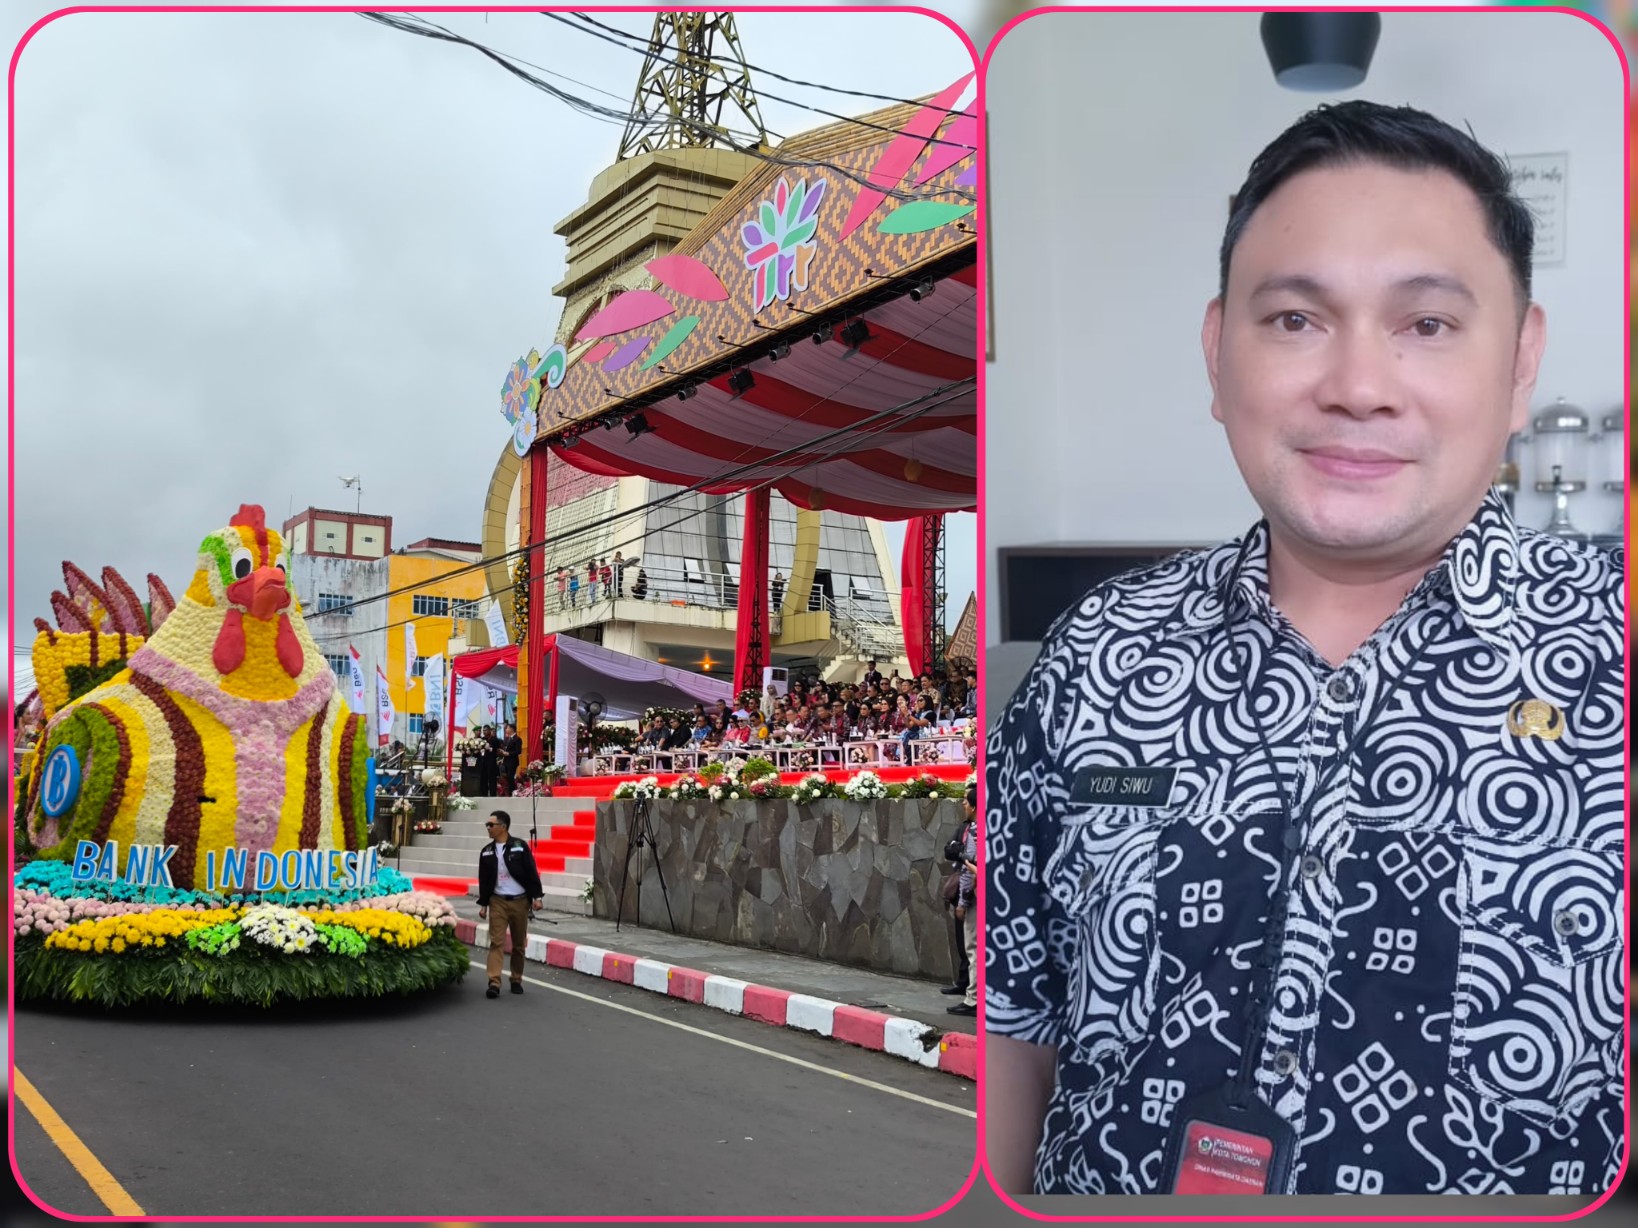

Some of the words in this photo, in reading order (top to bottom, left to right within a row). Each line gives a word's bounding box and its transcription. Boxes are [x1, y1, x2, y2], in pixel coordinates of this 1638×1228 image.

[1090, 776, 1117, 794] YUDI
[1120, 777, 1153, 794] SIWU
[71, 839, 179, 888] BANK
[206, 846, 379, 891] INDONESIA
